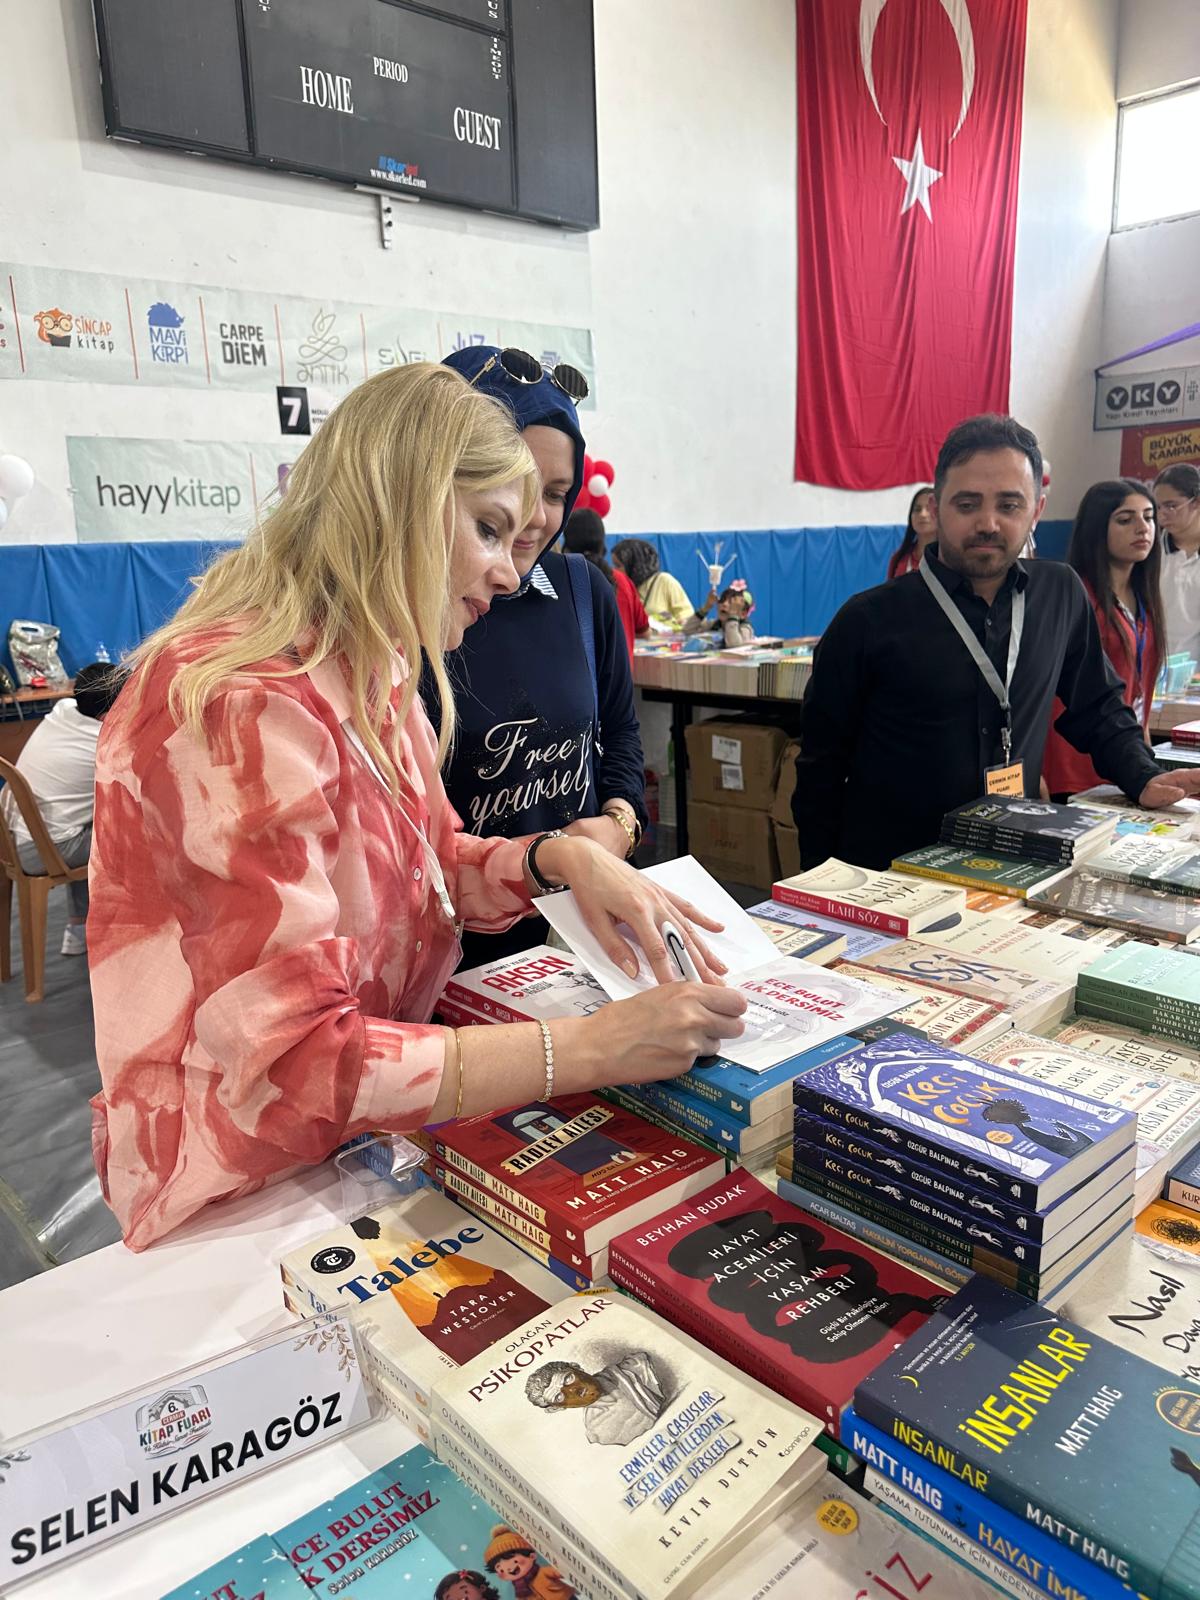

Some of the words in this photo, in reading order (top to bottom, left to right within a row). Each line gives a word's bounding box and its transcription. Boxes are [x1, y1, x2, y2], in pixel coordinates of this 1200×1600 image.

[373, 56, 408, 83] PERIOD
[300, 66, 354, 114] HOME
[453, 106, 501, 151] GUEST
[78, 335, 115, 353] kitap
[219, 323, 264, 342] CARPE
[281, 397, 302, 427] 7
[1149, 433, 1192, 451] BÜYÜK
[1149, 443, 1200, 462] KAMPAN
[96, 475, 241, 514] hayykitap
[478, 717, 578, 780] Free
[827, 900, 856, 919] İLAHİ
[858, 910, 880, 927] SÖZ
[482, 955, 574, 993] AHSEN
[764, 978, 796, 991] ECE
[794, 988, 846, 1009] BULUT
[766, 989, 845, 1021] DERSİMİZ
[1155, 995, 1190, 1010] BAKARA
[1158, 1002, 1200, 1019] SOHBETLE
[950, 1000, 984, 1028] PİŞGİN
[1151, 1024, 1186, 1039] BAKARA
[1152, 1008, 1186, 1024] BAKARA
[1110, 1038, 1145, 1062] AYET
[1130, 1050, 1155, 1067] EDİ
[1149, 1048, 1183, 1073] SİYET
[1057, 1066, 1099, 1090] ALBİNE
[1087, 1072, 1131, 1101] LCULUK
[685, 1105, 714, 1127] ADSHEAD
[1156, 1085, 1197, 1114] PİŞGİN
[509, 1134, 565, 1171] RADLEY
[907, 1140, 928, 1156] ÖZGÜR
[928, 1149, 960, 1170] BALPINAR
[450, 1151, 469, 1174] RADLEY
[492, 1179, 515, 1203] MATT
[518, 1195, 540, 1220] HAIG
[566, 1175, 628, 1210] MATT
[634, 1149, 688, 1176] HAIG
[910, 1171, 932, 1187] ÖZGÜR
[933, 1180, 965, 1202] BALPINAR
[1181, 1189, 1200, 1205] KUR
[450, 1175, 470, 1197] RADLEY
[494, 1204, 518, 1228] MATT
[521, 1219, 544, 1245] HAIG
[636, 1211, 699, 1247] BEYHAN
[697, 1185, 748, 1216] BUDAK
[809, 1201, 830, 1217] ACAR
[827, 1180, 862, 1201] ZENGİNLİK
[937, 1231, 971, 1253] STRATEJİ
[909, 1198, 931, 1214] ÖZGÜR
[931, 1207, 964, 1230] BALPINAR
[708, 1228, 762, 1260] HAYAT
[826, 1191, 862, 1215] ZENGİNLİK
[936, 1244, 970, 1266] STRATEJİ
[337, 1226, 485, 1305] Talebe
[611, 1250, 635, 1274] BEYHAN
[635, 1266, 657, 1289] BUDAK
[712, 1230, 799, 1284] ACEMİLERİ
[753, 1257, 798, 1285] İÇİN
[610, 1268, 634, 1291] BEYHAN
[635, 1284, 656, 1305] BUDAK
[768, 1266, 829, 1304] YAŞAM
[785, 1273, 858, 1322] REHBERİ
[1107, 1269, 1186, 1339] Nasıl
[440, 1289, 518, 1336] WESTOVER
[450, 1292, 490, 1318] TARA
[819, 1319, 838, 1336] Güçlü
[836, 1314, 847, 1325] Bir
[845, 1297, 878, 1319] Psikolojiye
[504, 1318, 554, 1354] OLAĞAN
[826, 1327, 848, 1344] Sahip
[845, 1313, 872, 1333] Olmanın
[467, 1297, 614, 1403] PSİKOPATLAR
[168, 1401, 179, 1413] 6.
[958, 1327, 1092, 1454] İNSANLAR
[139, 1424, 174, 1447] KİTAP
[177, 1406, 212, 1433] FUARI
[666, 1390, 717, 1439] CASUSLAR
[1055, 1408, 1099, 1457] MATT
[1089, 1384, 1123, 1421] HAIG
[623, 1492, 640, 1509] VE
[637, 1470, 664, 1498] SERİ
[658, 1411, 725, 1478] KATİLLERDEN
[781, 1425, 811, 1458] domingo
[11, 1479, 140, 1565] SELEN
[152, 1391, 343, 1506] KARAGÖZ
[441, 1407, 480, 1450] OLAĞAN
[483, 1447, 551, 1516] PSİKOPATLAR
[657, 1475, 690, 1509] HAYAT
[687, 1433, 731, 1480] DERSLERİ
[658, 1496, 712, 1549] KEVIN
[718, 1427, 779, 1490] DUTTON
[892, 1417, 989, 1493] İNSANLAR
[1026, 1502, 1080, 1547] MATT
[1082, 1536, 1131, 1580] HAIG
[288, 1533, 330, 1569] CE
[327, 1480, 408, 1542] BULUT
[321, 1488, 441, 1575] DERSİMİZ
[441, 1433, 480, 1475] OLAĞAN
[483, 1472, 551, 1541] PSİKOPATLAR
[561, 1546, 588, 1575] KEVIN
[591, 1572, 621, 1600] DUTTO
[446, 1458, 487, 1500] OLAĞAN
[490, 1498, 560, 1570] PSİKOPATLAR
[853, 1431, 899, 1478] MATT
[901, 1466, 943, 1511] HAIG
[978, 1522, 1043, 1582] HAYAT
[1048, 1565, 1090, 1600] İMK
[873, 1478, 911, 1512] YAŞAMA
[914, 1508, 967, 1552] TUTUNMAK
[968, 1544, 992, 1571] İÇİN
[327, 1567, 365, 1596] Selen
[363, 1528, 420, 1571] KARAGÖZ
